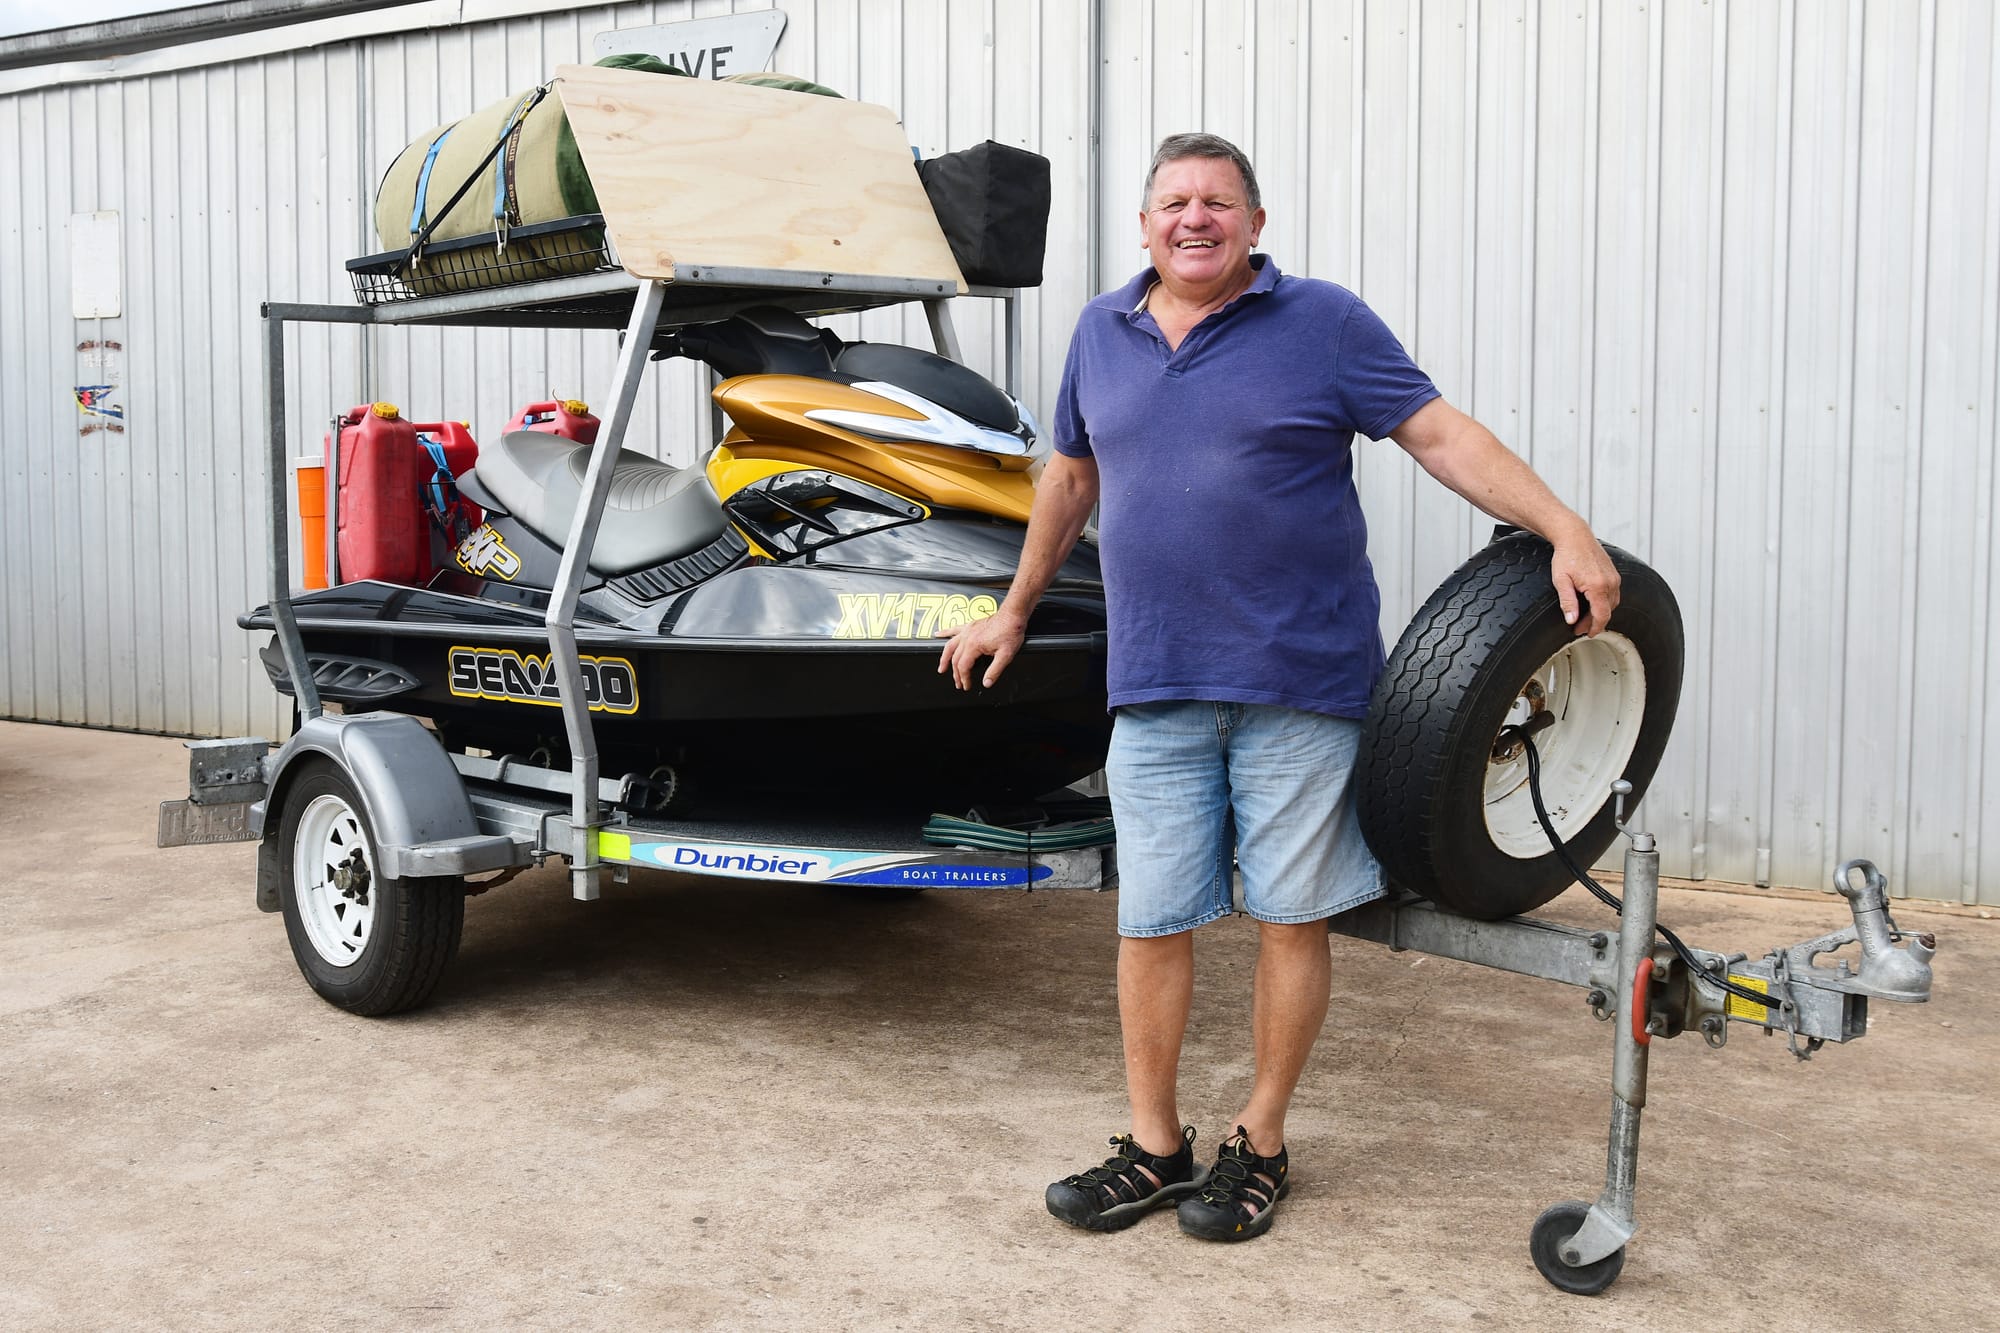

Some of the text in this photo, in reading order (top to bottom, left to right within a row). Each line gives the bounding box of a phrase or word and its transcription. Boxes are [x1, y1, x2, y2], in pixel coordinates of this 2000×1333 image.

[668, 46, 733, 80] IVE
[832, 592, 999, 639] XV176S
[673, 847, 817, 875] Dunbier
[903, 870, 1007, 882] BOAT TRAILERS
